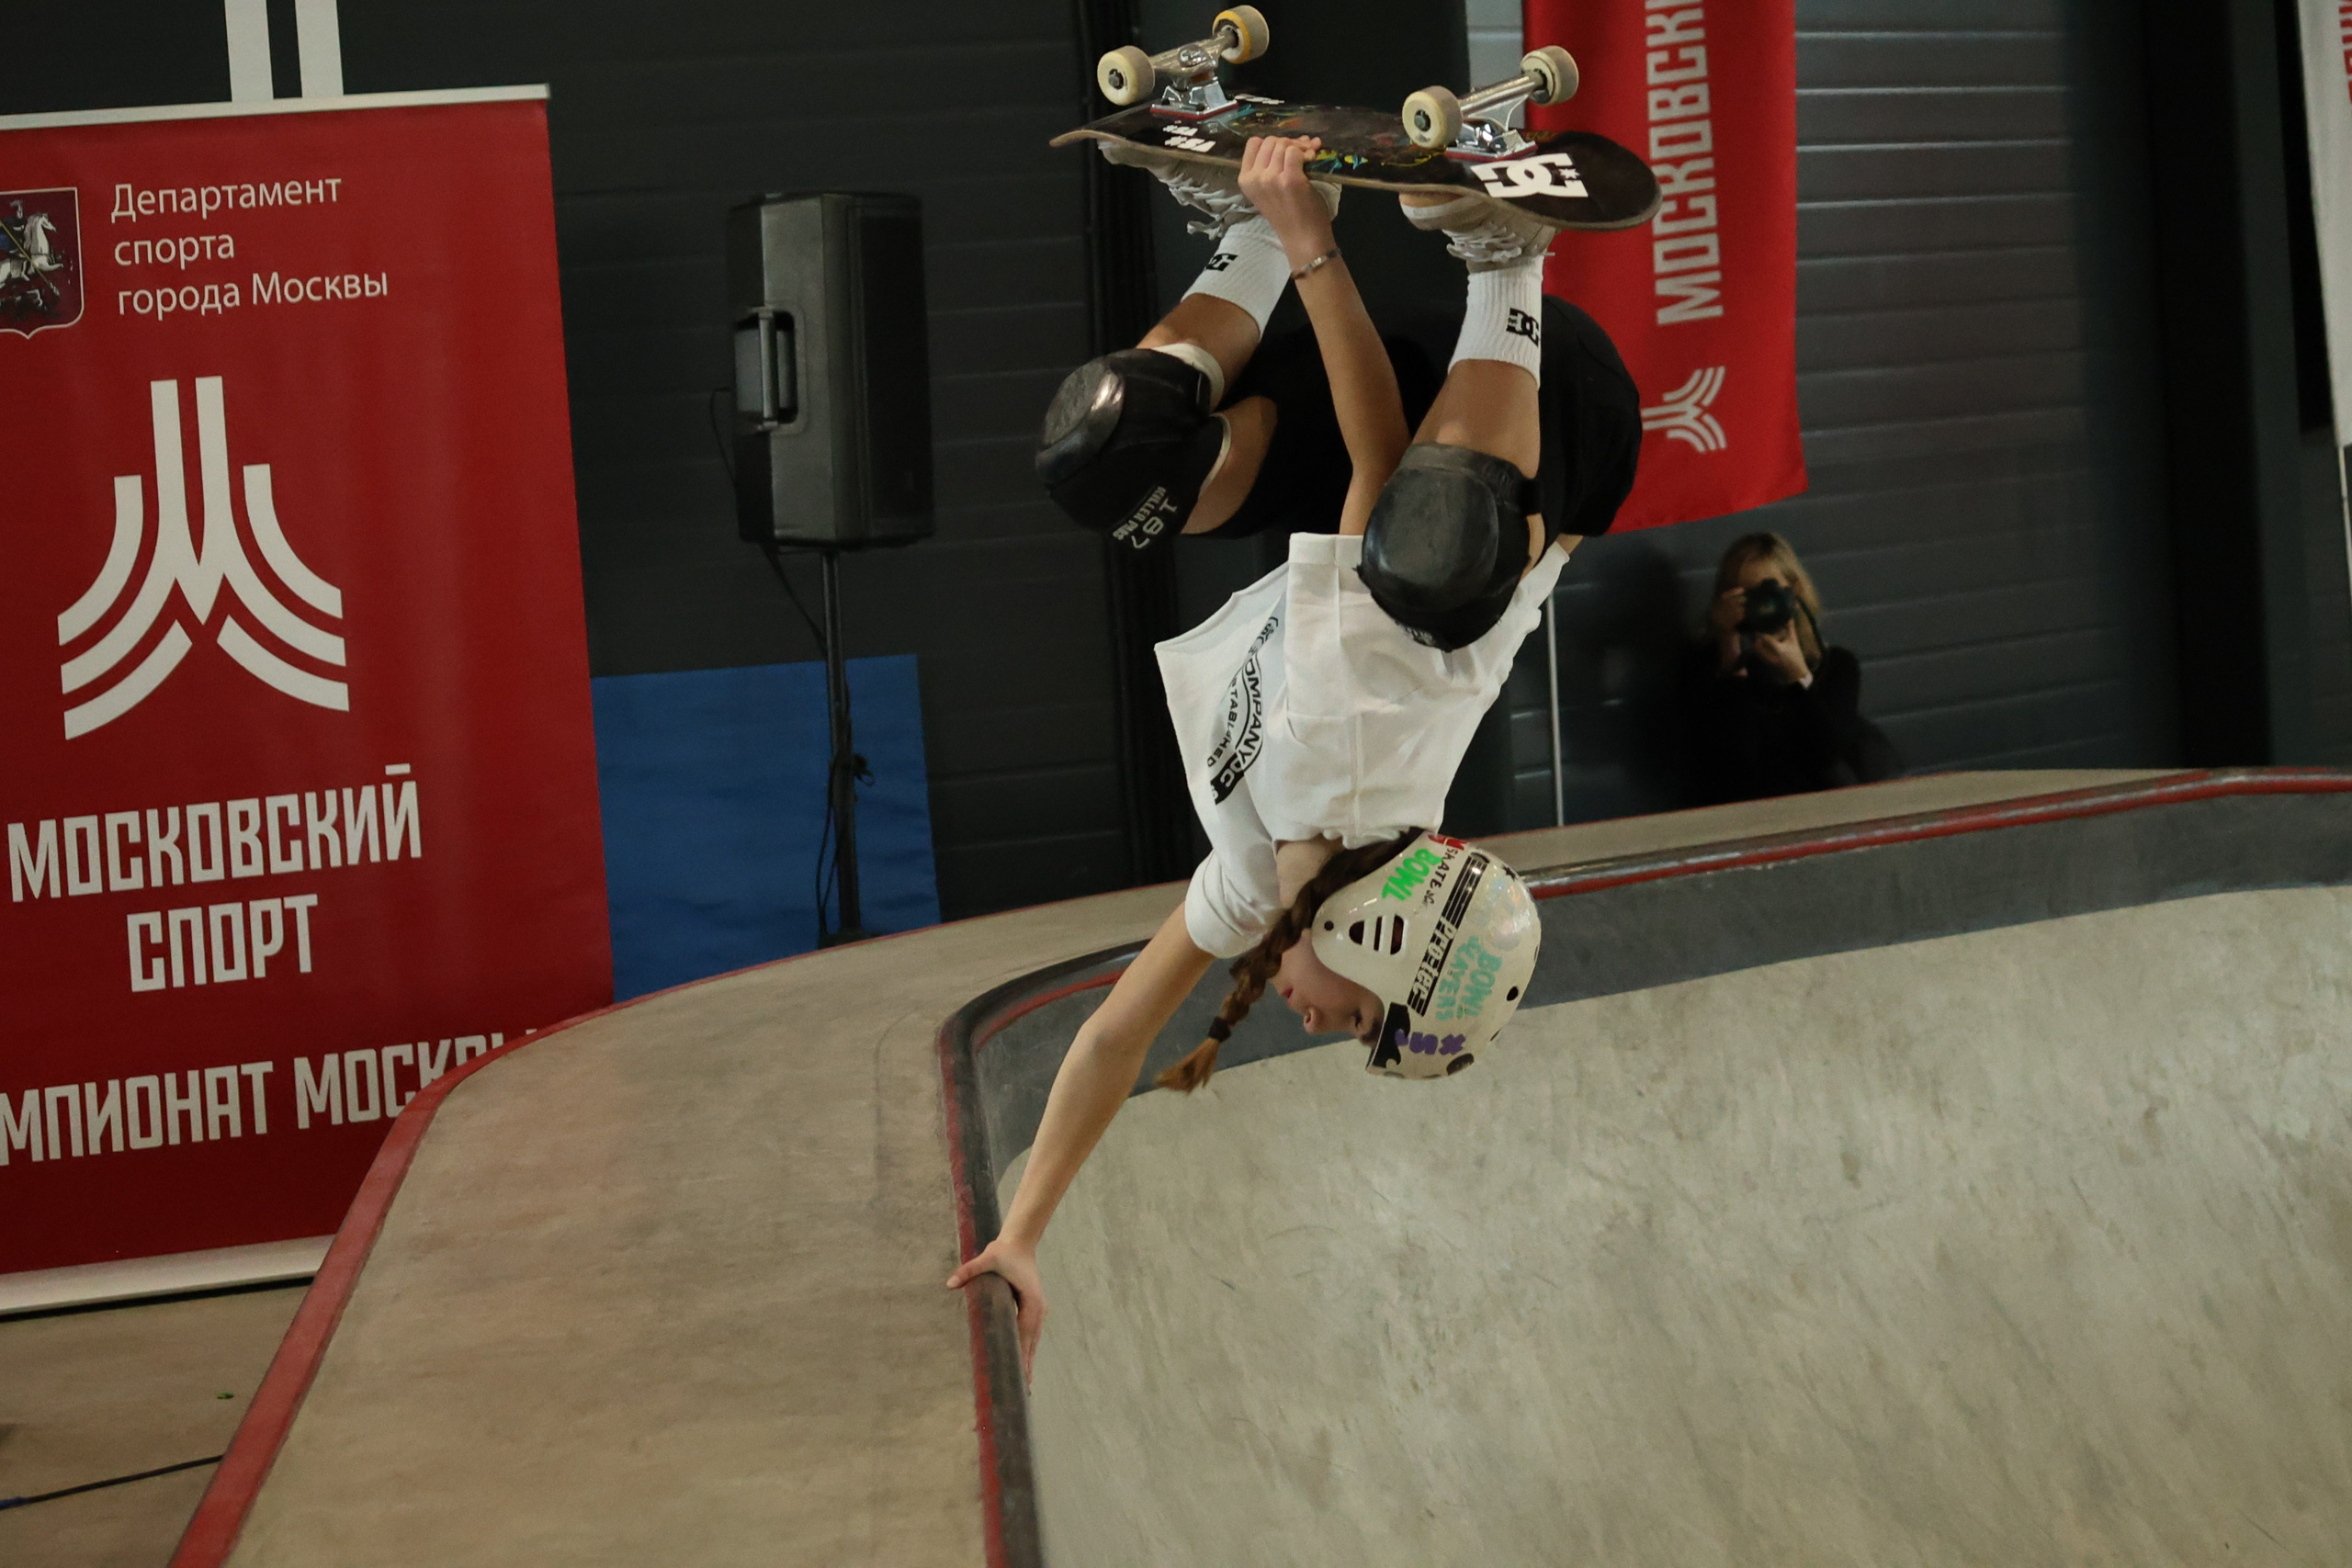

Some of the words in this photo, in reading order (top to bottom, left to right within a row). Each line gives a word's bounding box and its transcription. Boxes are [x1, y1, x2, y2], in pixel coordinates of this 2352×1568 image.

[110, 177, 342, 224] Департамент
[114, 233, 235, 270] спорта
[119, 282, 241, 321] города
[253, 271, 389, 306] Москвы
[1130, 497, 1178, 549] 187
[1238, 657, 1263, 765] OMPANY
[7, 762, 423, 902] МОСКОВСКИЙ
[1381, 847, 1443, 901] BOWL
[127, 893, 319, 993] СПОРТ
[1457, 950, 1503, 1020] BOWL
[0, 1060, 274, 1167] МПИОНАТ
[293, 1028, 537, 1130] МОСК
